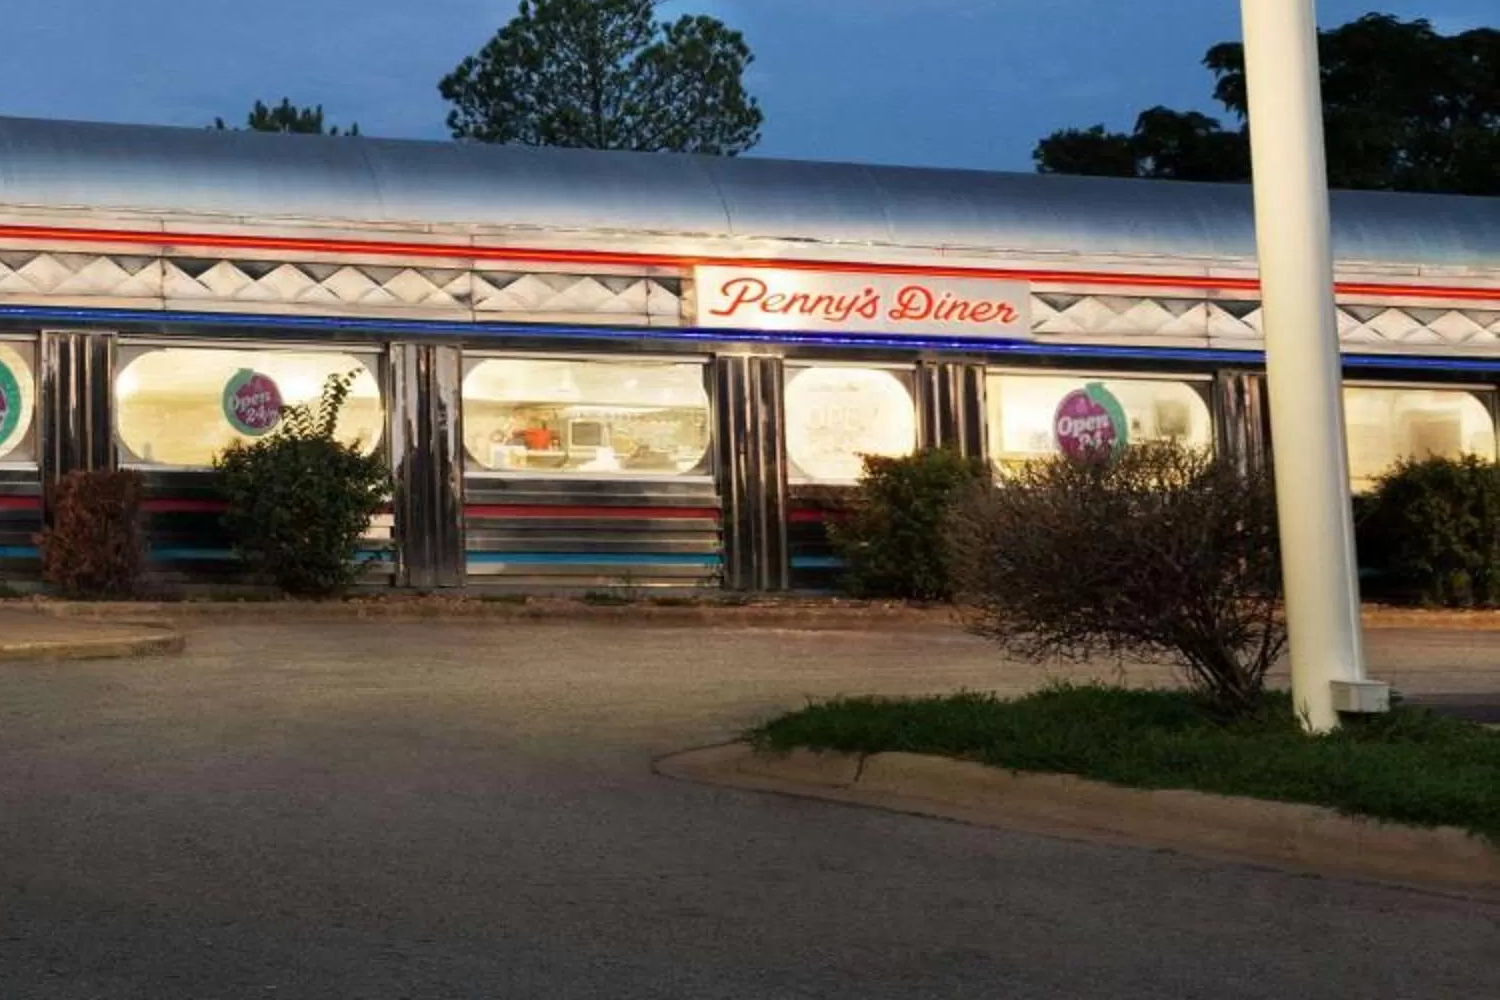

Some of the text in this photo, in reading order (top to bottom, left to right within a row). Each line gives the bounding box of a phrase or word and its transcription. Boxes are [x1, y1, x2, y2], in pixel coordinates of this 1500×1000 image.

[709, 277, 1019, 324] Penny's Diner
[1058, 415, 1110, 437] Open
